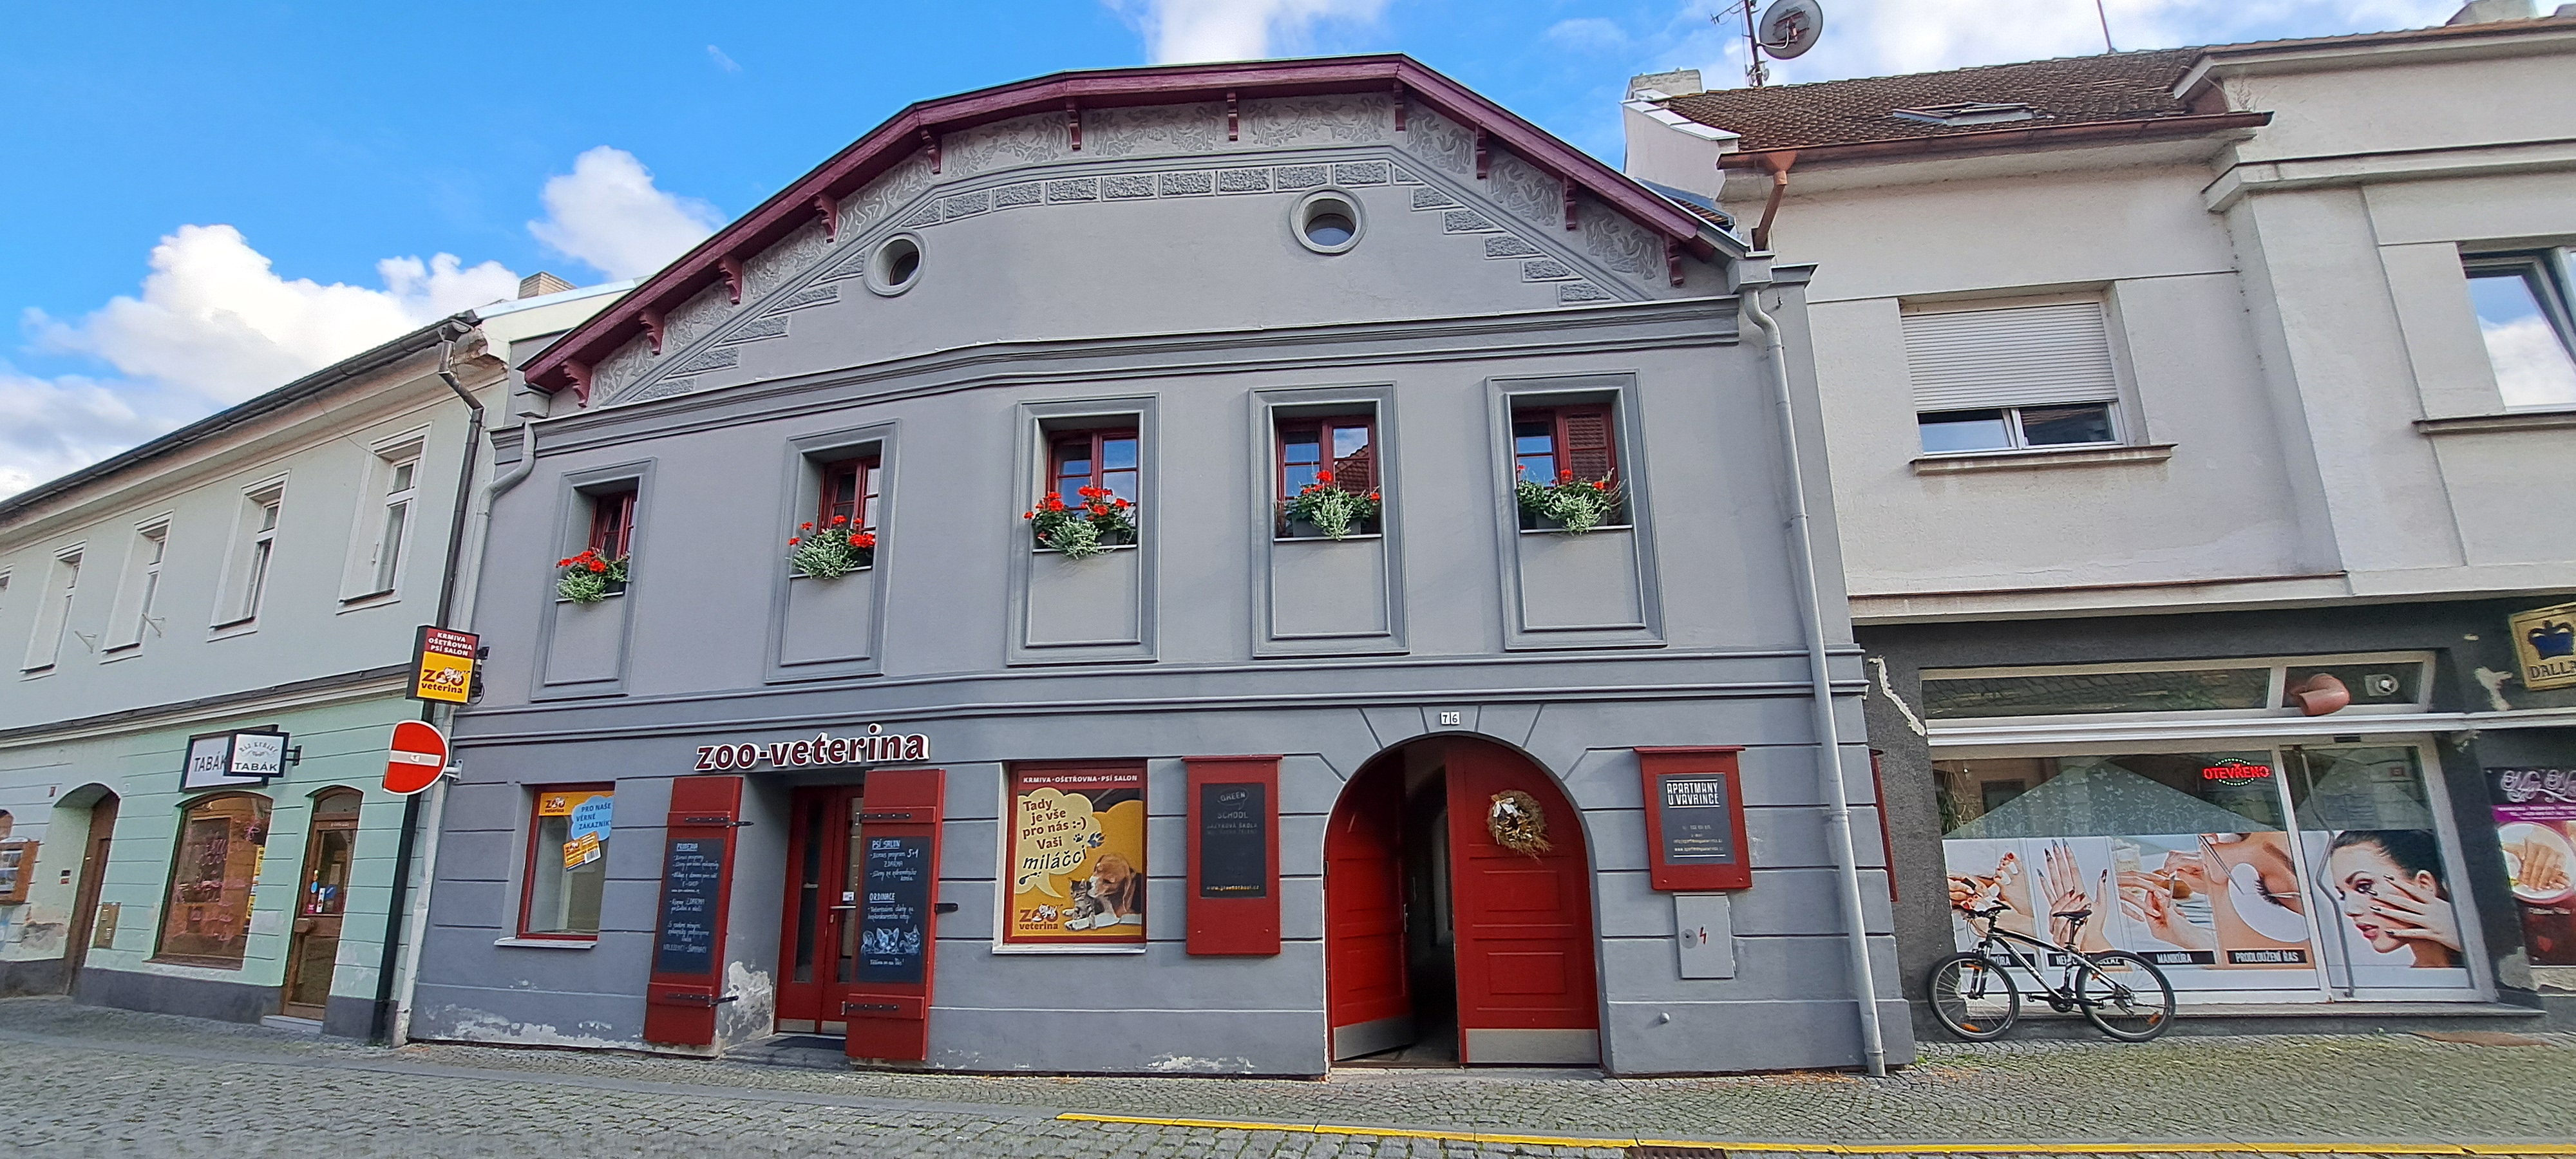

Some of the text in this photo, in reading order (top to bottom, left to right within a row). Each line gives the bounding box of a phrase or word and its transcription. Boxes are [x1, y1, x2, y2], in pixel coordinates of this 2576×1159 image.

[428, 637, 472, 650] OŠETŘOVNA
[437, 632, 466, 643] KRMIVA
[444, 648, 468, 656] SALON
[422, 683, 462, 693] veterina
[1443, 714, 1457, 722] 76
[695, 723, 929, 771] zoo-veterina
[235, 762, 277, 771] TABÁK
[2204, 763, 2269, 779] OTEVŘENO
[1667, 782, 1718, 794] APARTMANY
[1023, 798, 1052, 811] Tady
[1668, 793, 1719, 805] U VAVRINCE
[1031, 808, 1066, 825] je vše
[579, 820, 611, 829] ZÁKAZNÍK
[1023, 826, 1044, 840] pro
[1048, 820, 1069, 833] nás
[1036, 836, 1063, 849] Vaši
[1023, 845, 1086, 869] miláčci
[1019, 921, 1058, 930] veterina
[2157, 952, 2192, 963] MANIKÚRA
[2235, 950, 2282, 963] PRODLOUŽENÍ
